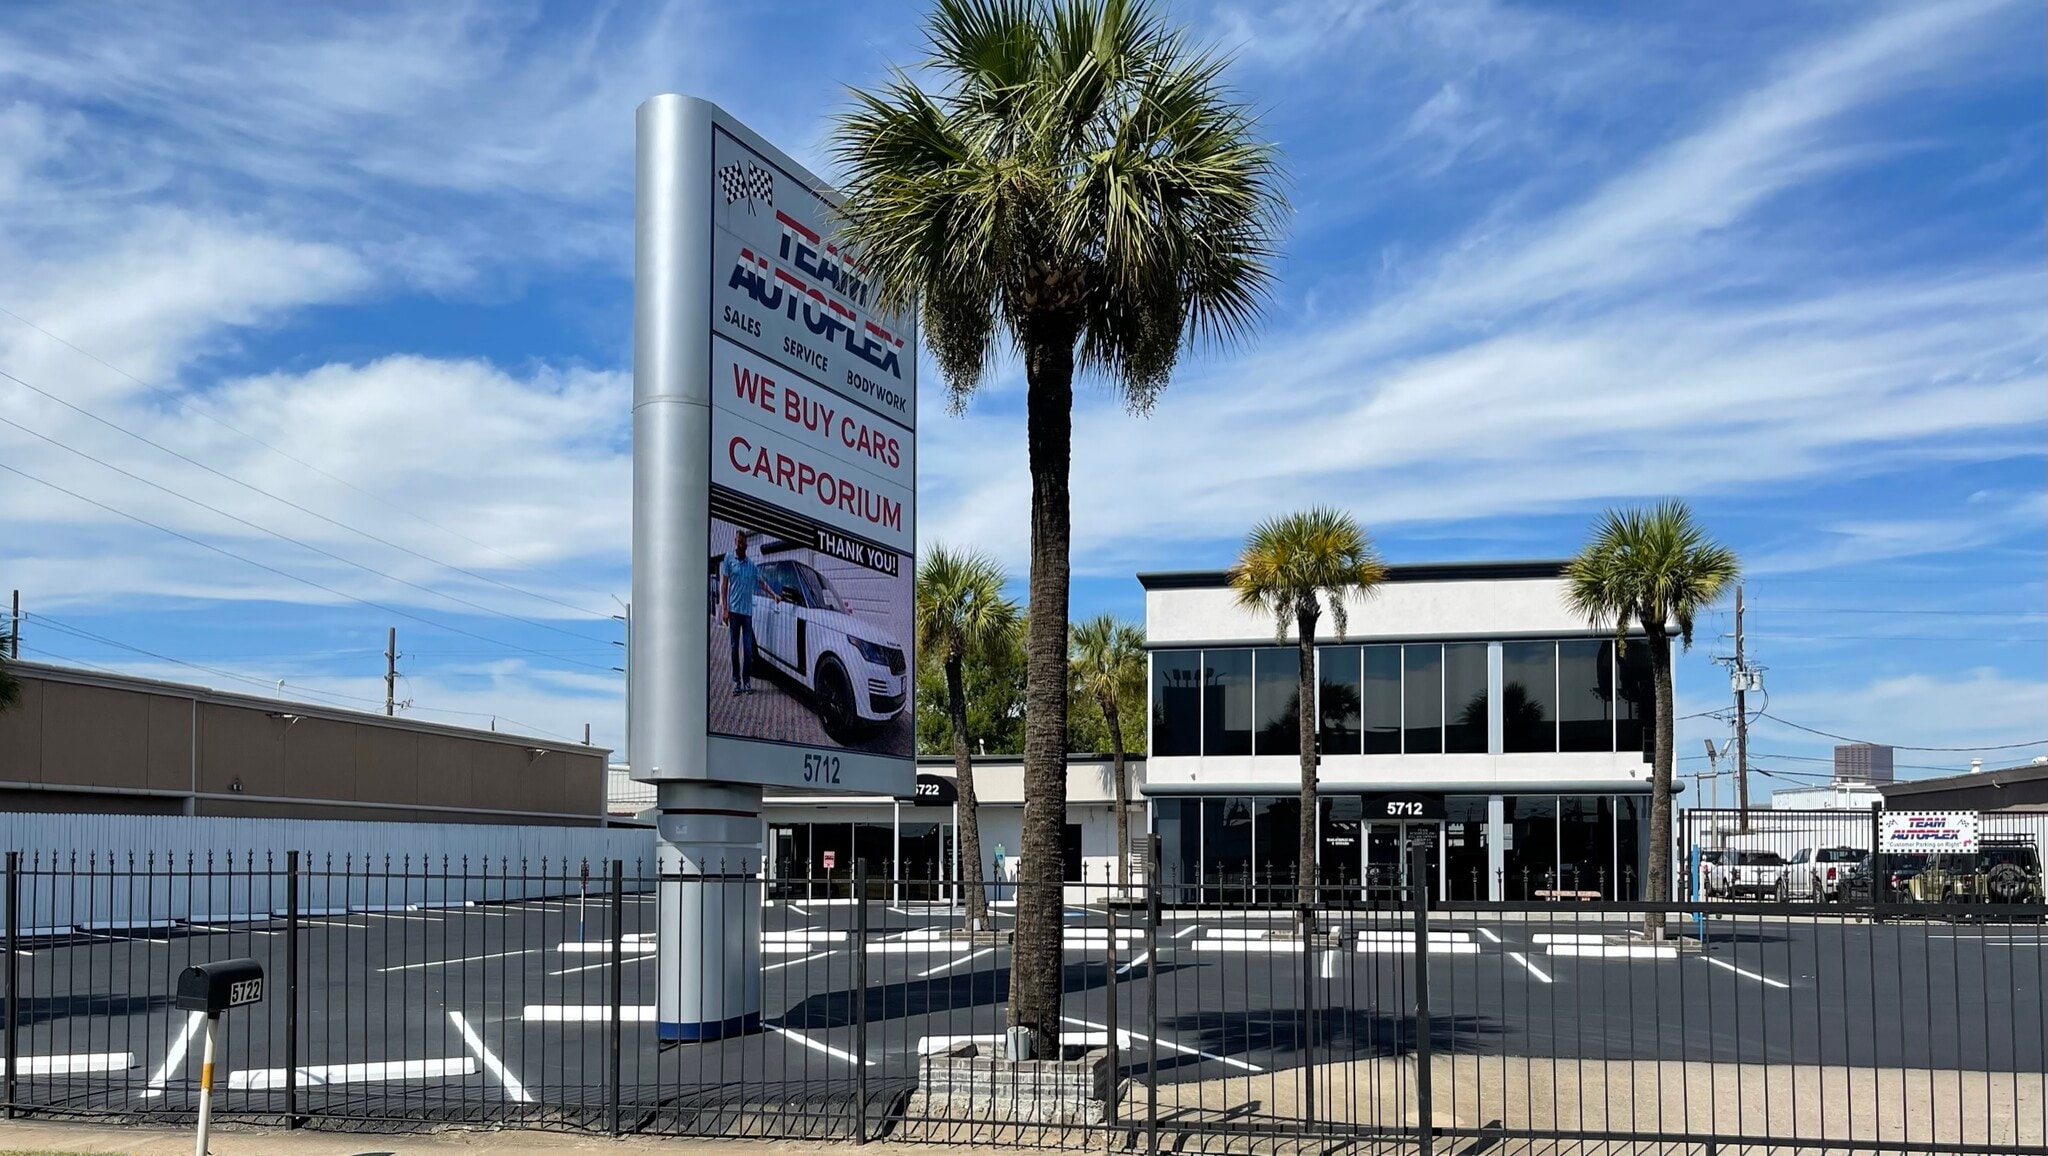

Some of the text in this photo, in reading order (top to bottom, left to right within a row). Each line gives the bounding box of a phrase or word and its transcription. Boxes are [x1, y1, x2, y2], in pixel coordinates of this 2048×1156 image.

[776, 209, 870, 307] TEAM
[729, 247, 904, 380] AUTOPLEX
[724, 305, 906, 413] SALES SERVICE BODYWORK
[733, 363, 900, 469] WE BUY CARS
[728, 436, 901, 532] CARPORIUM
[817, 530, 896, 574] THANK YOU!
[804, 753, 840, 784] 5712
[1387, 801, 1423, 816] 5712
[1909, 817, 1947, 828] TEAM
[1890, 829, 1960, 840] AUTOPLEX
[1916, 841, 1936, 849] Parking
[231, 981, 260, 1003] 5722
